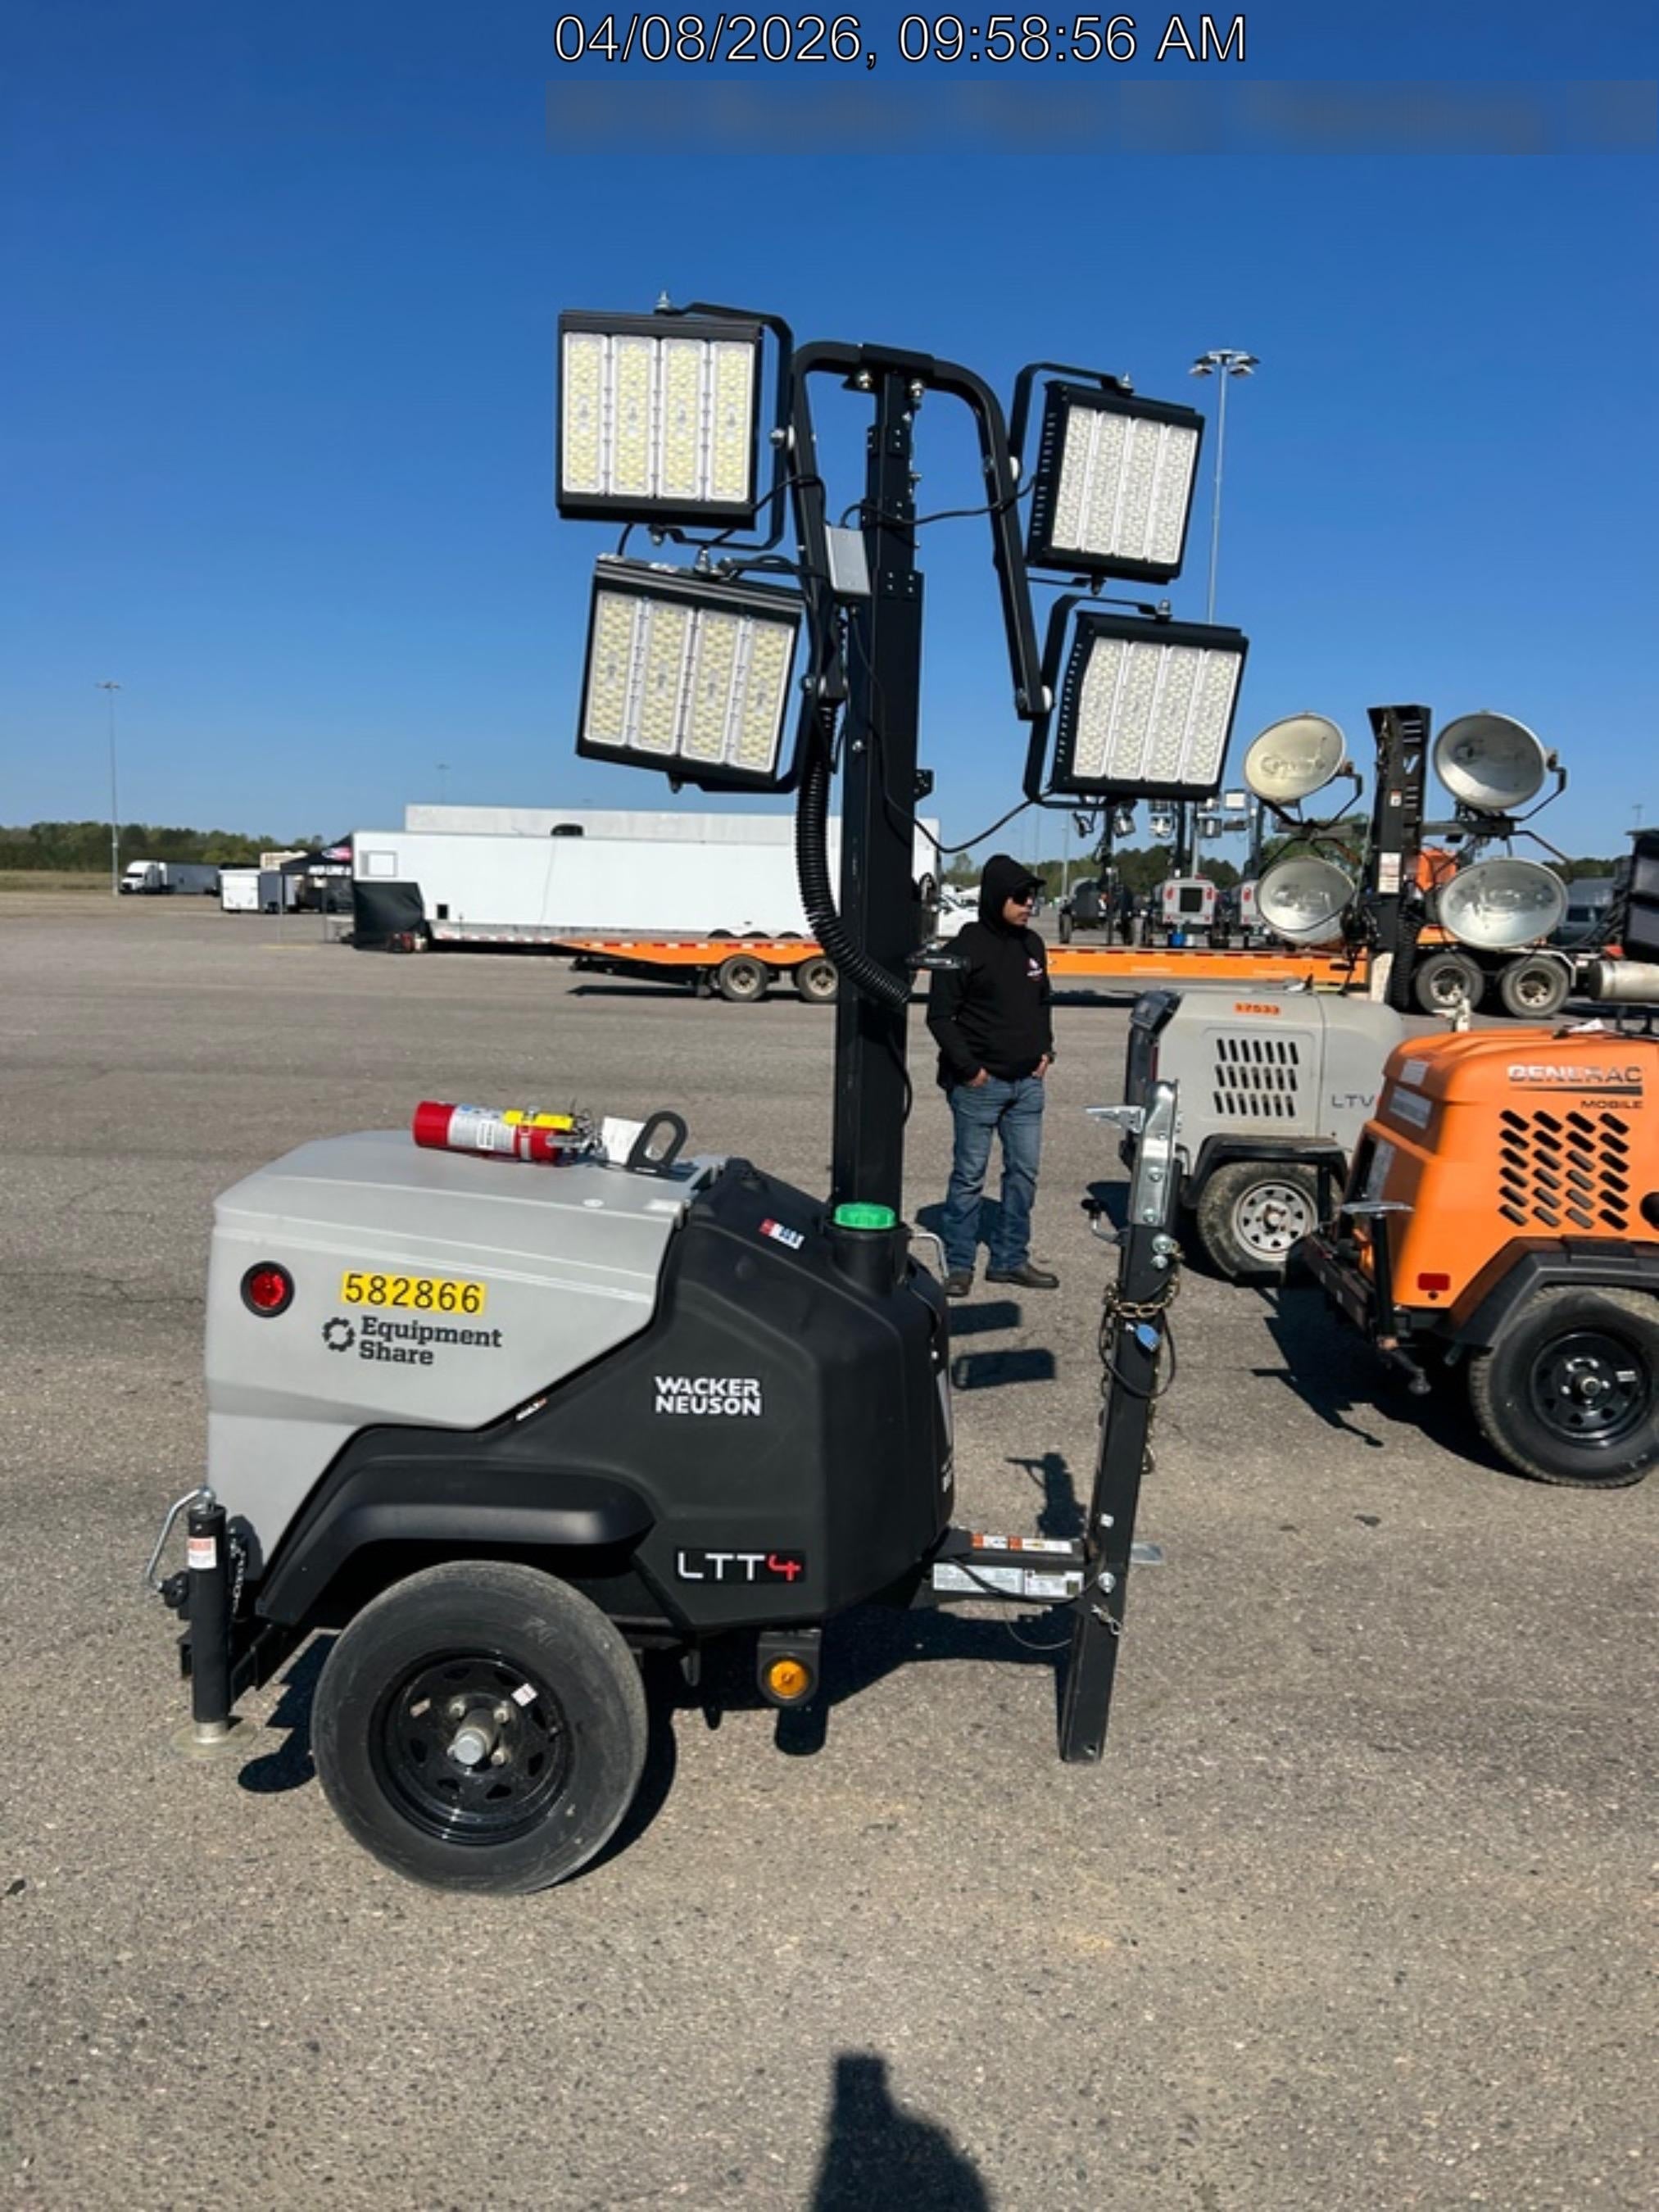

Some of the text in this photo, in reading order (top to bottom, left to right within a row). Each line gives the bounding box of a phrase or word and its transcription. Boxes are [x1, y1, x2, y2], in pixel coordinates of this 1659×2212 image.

[1508, 1065, 1643, 1082] GENERAC
[1580, 1100, 1643, 1108] MOBILE
[345, 1273, 481, 1313] 582866
[360, 1315, 502, 1348] Equipment
[359, 1339, 434, 1365] Share
[654, 1376, 760, 1397] WACKER
[655, 1395, 761, 1416] NEUSON
[678, 1552, 802, 1581] LTT4
